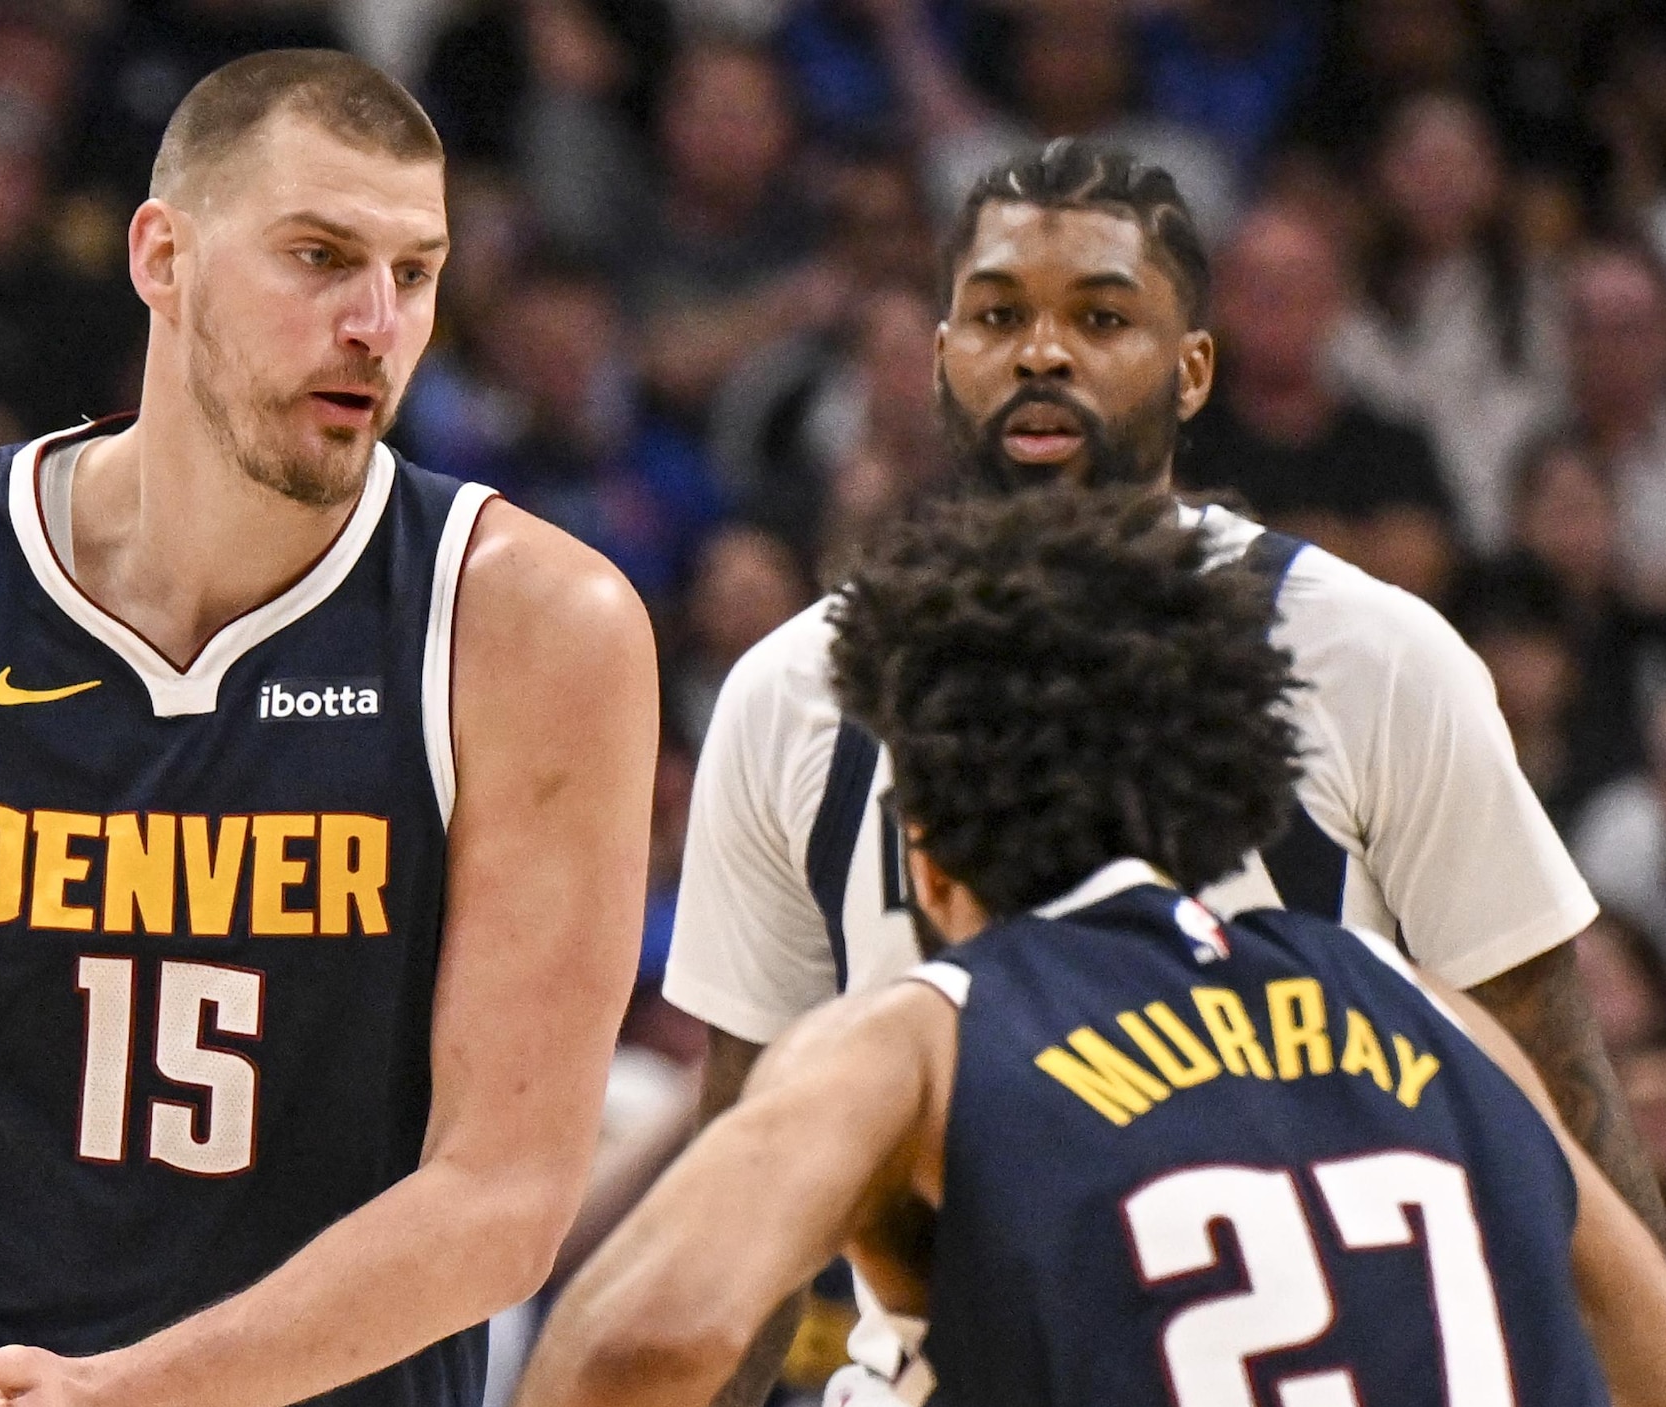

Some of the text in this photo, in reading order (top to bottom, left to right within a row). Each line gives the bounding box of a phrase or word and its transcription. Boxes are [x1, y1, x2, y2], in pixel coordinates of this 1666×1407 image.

[259, 684, 379, 719] ibotta
[75, 953, 265, 1177] 15
[1035, 977, 1440, 1127] MURRAY
